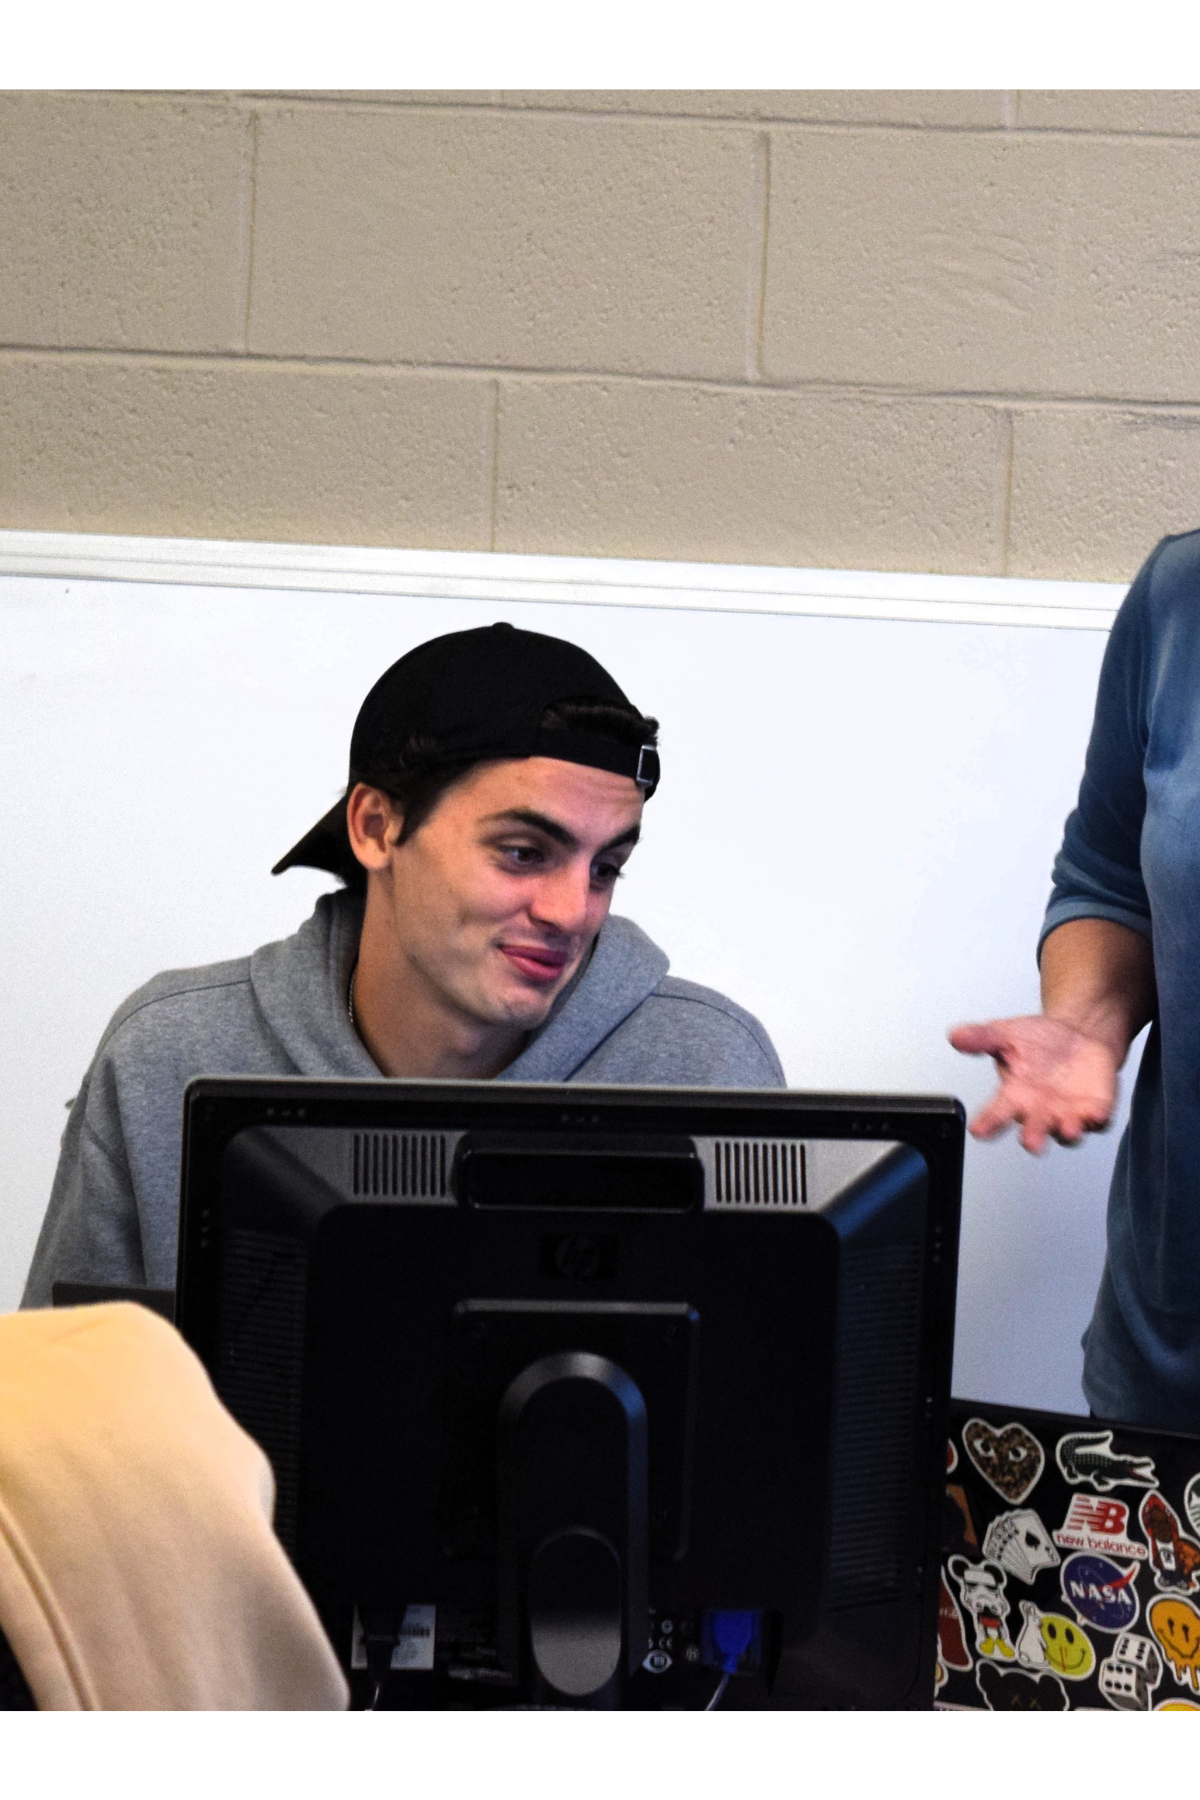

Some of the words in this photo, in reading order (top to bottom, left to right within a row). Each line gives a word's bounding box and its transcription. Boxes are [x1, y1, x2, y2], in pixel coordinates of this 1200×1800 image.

[1056, 1532, 1085, 1547] new
[1087, 1535, 1146, 1557] balance
[1069, 1580, 1133, 1606] NASA
